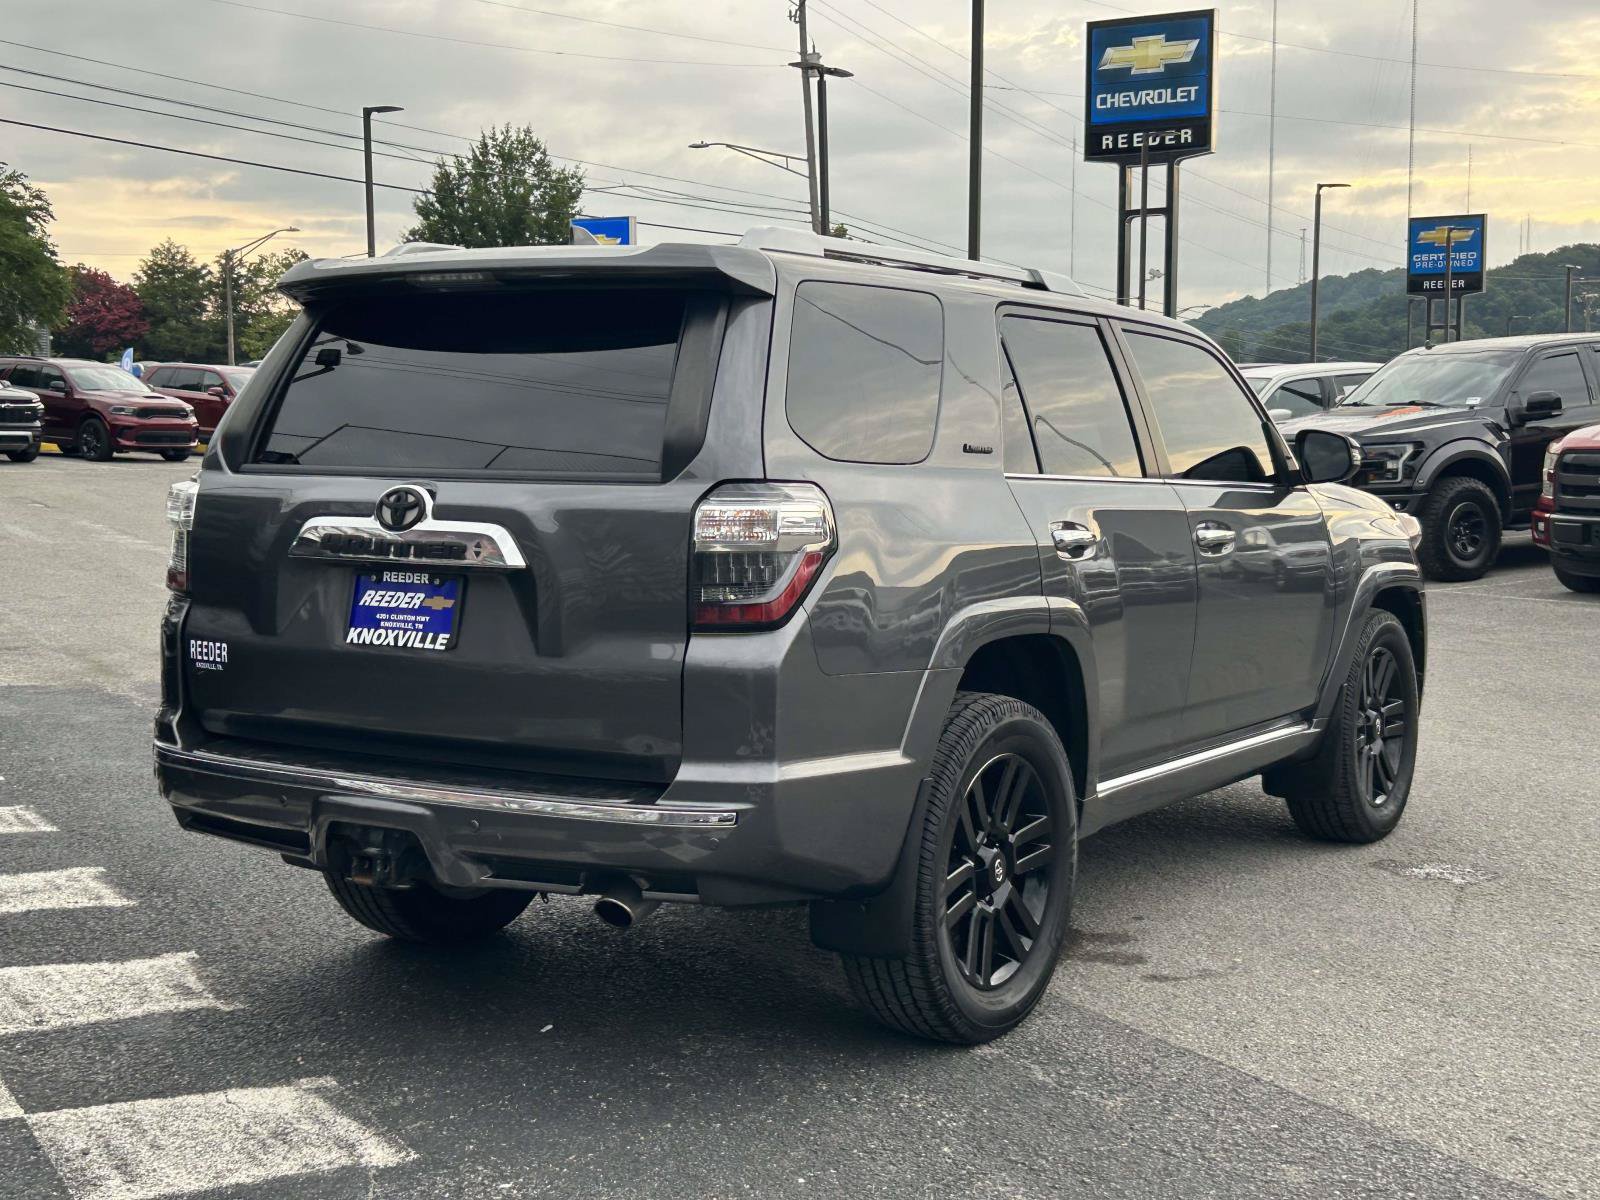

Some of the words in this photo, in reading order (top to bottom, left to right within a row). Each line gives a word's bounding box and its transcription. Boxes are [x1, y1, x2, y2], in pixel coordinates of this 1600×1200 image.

[1096, 86, 1199, 109] CHEVROLET
[1102, 128, 1192, 149] REEDER
[1413, 252, 1476, 261] CERTFIED
[1423, 279, 1465, 289] REEER
[383, 571, 429, 584] REEDER
[359, 590, 425, 609] REEDER
[346, 627, 451, 650] KNOXVILLE
[190, 639, 228, 663] REEDER
